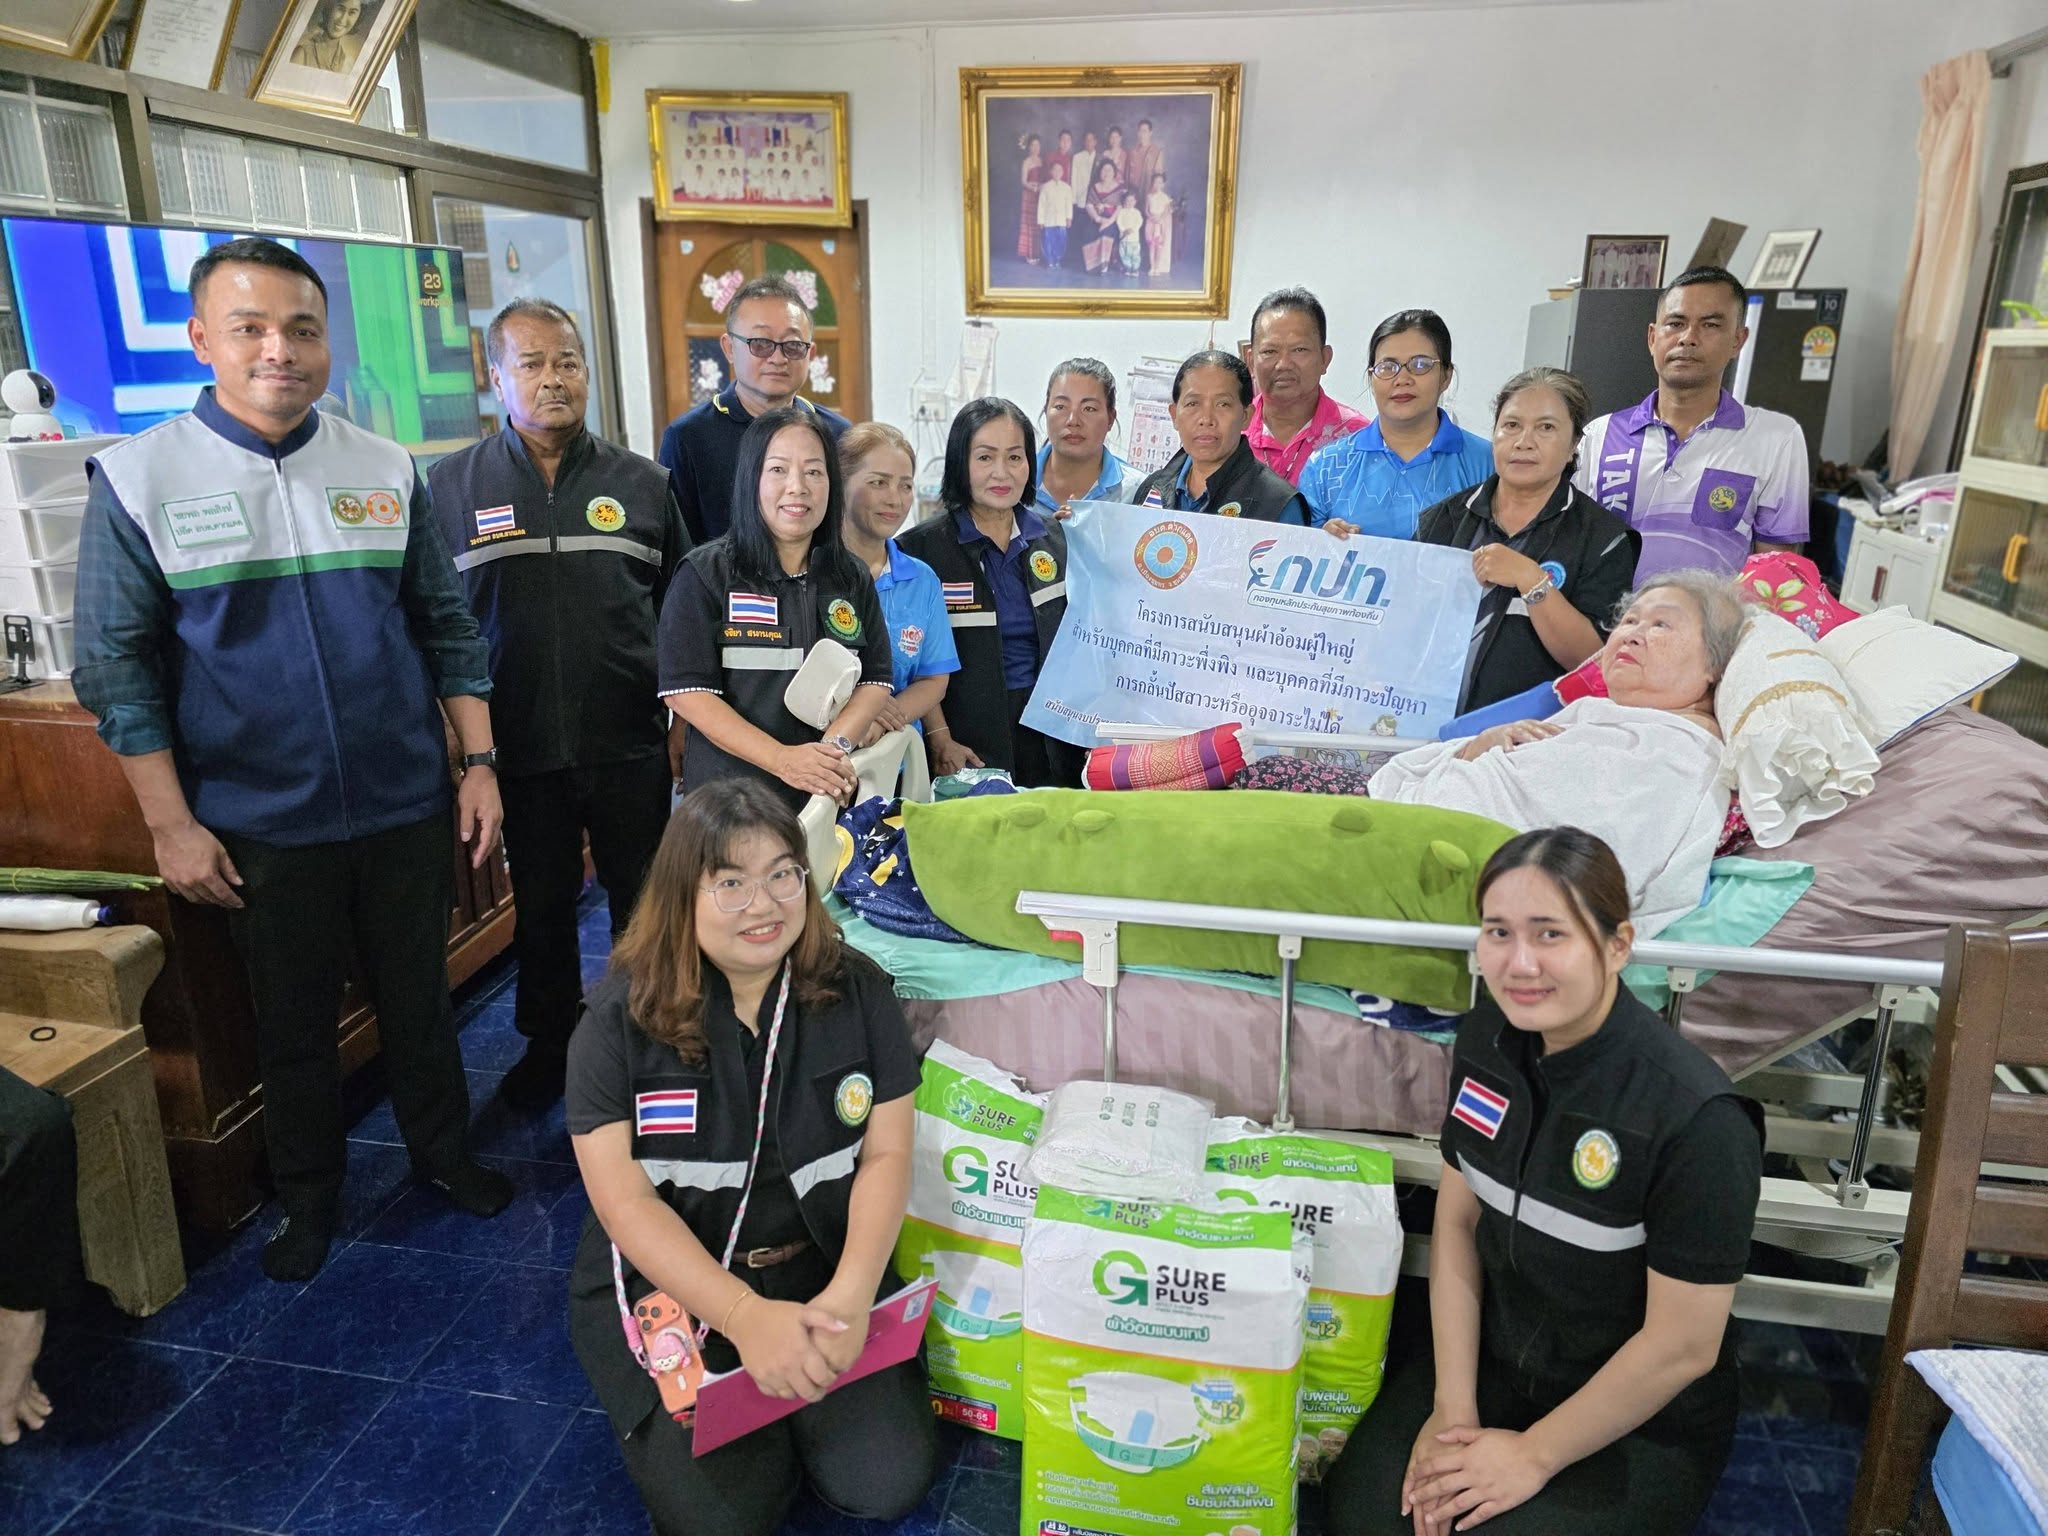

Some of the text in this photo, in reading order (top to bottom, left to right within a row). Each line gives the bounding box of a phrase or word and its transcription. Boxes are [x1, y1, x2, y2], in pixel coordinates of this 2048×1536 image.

[423, 273, 441, 289] 23
[1825, 299, 1838, 311] 10
[1136, 433, 1142, 442] 3
[1165, 437, 1171, 447] 5
[1133, 447, 1171, 461] 10 11 12
[1602, 448, 1635, 512] TAK
[1270, 550, 1391, 607] กปท.
[1137, 600, 1354, 664] โครงการสนับสนุนผ้าอ้อมผู้ใหญ่
[1246, 665, 1427, 716] และบุคคลที่มีภาวะปัญหา
[972, 1115, 1003, 1132] PLUS
[977, 1104, 1016, 1127] SURE
[995, 1160, 1020, 1181] SU
[993, 1180, 1038, 1200] PLUS
[952, 1200, 1026, 1229] ผ้าอ้อมแบบเ
[1115, 1211, 1149, 1230] PLUS
[1270, 1201, 1334, 1225] URE
[1156, 1265, 1226, 1292] SURE
[1156, 1288, 1209, 1307] PLUS
[1105, 1314, 1209, 1342] ผ้าอ้อมแบบเทป
